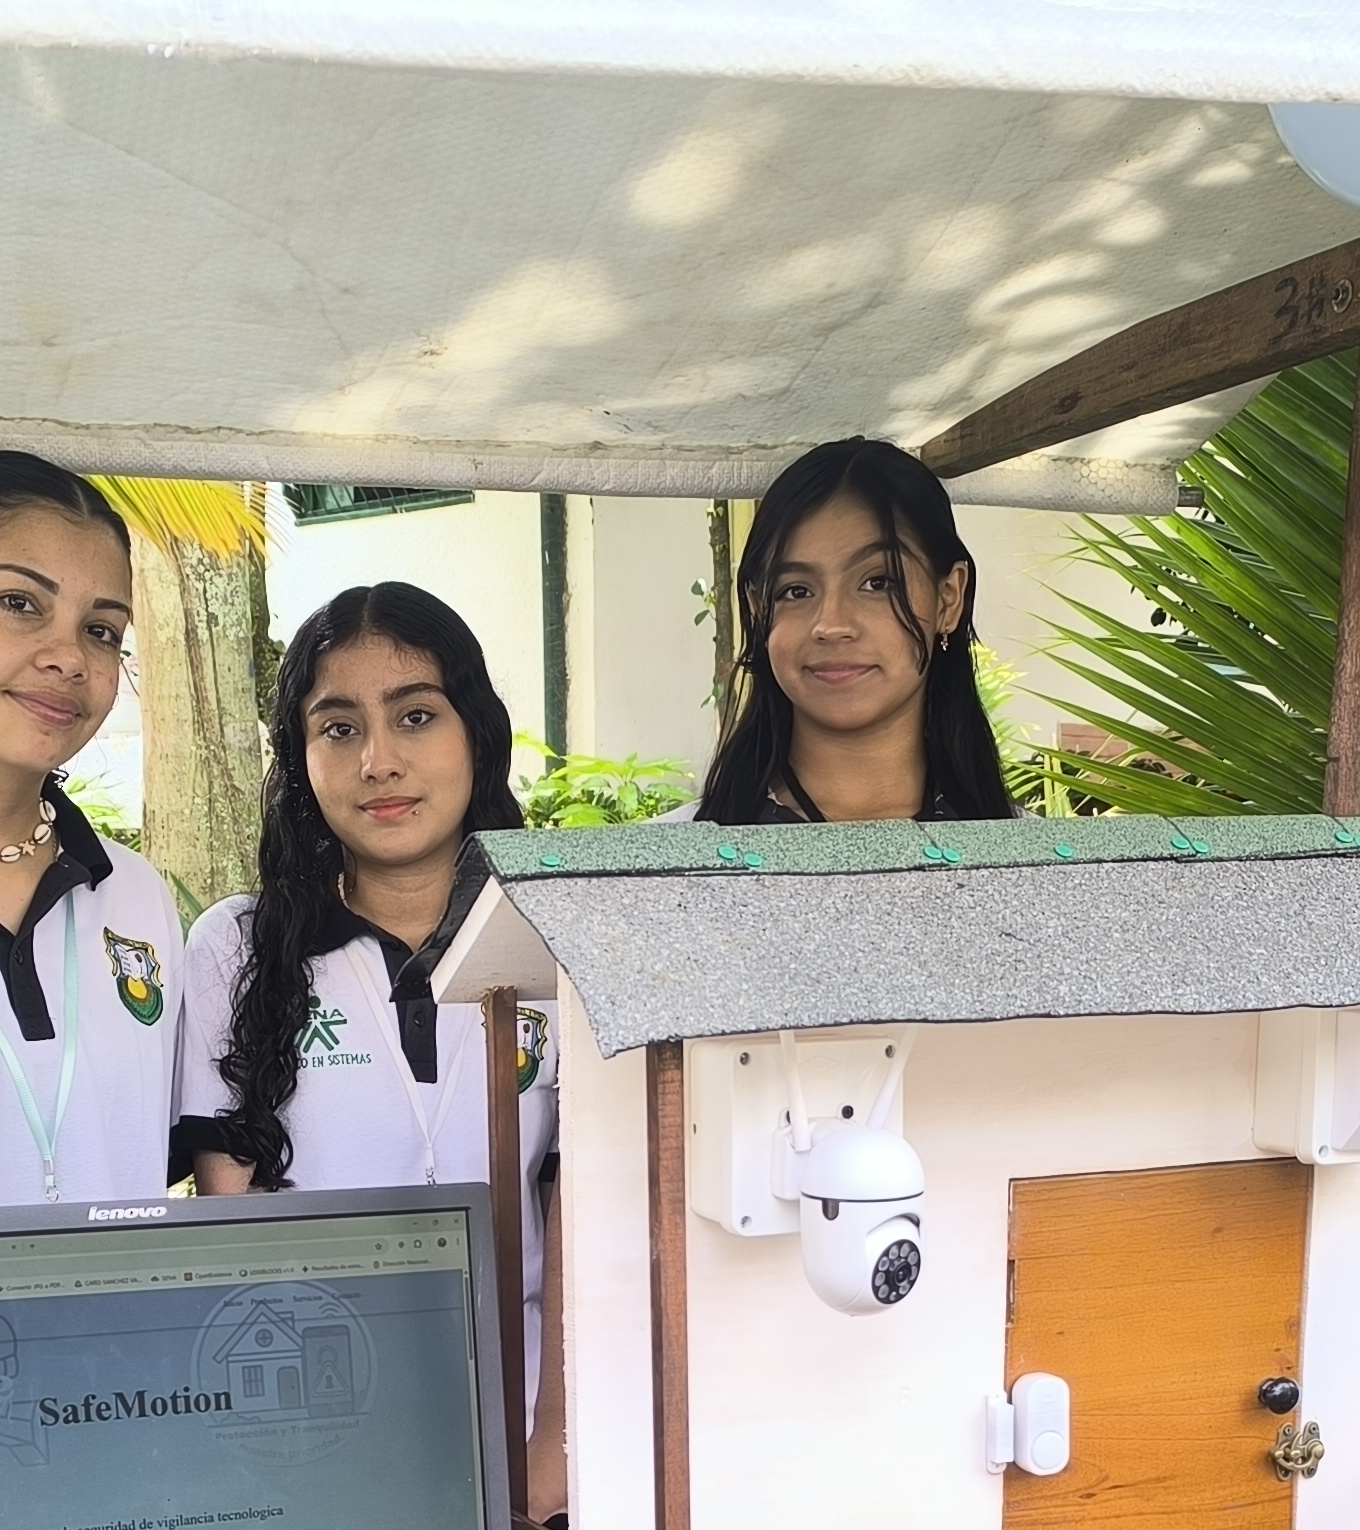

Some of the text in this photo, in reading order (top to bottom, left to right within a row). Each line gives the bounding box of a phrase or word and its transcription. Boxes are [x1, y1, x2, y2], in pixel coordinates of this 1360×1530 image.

[312, 1056, 323, 1067] EN
[328, 1054, 371, 1065] SISTEMAS
[88, 1206, 167, 1220] lenovo
[39, 1386, 233, 1427] SafeMotion
[291, 1420, 359, 1434] Tranquilidad
[139, 1518, 153, 1530] de
[157, 1512, 214, 1530] vigilancia
[217, 1506, 284, 1523] tecnologica
